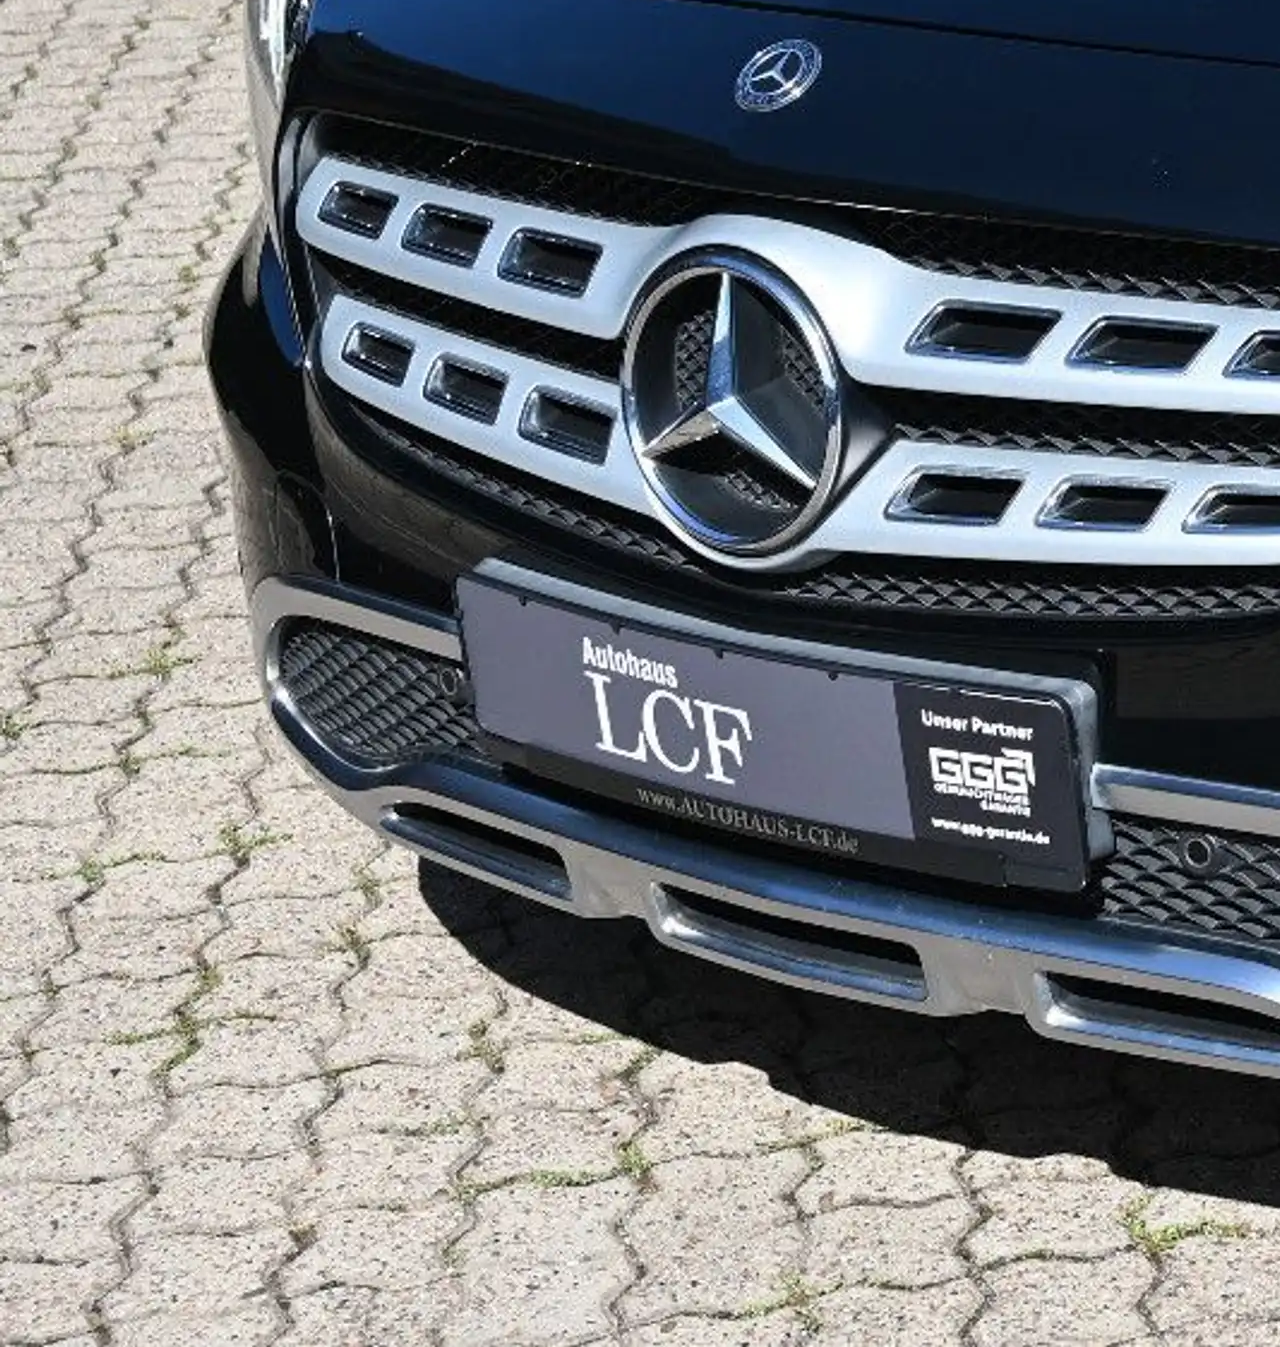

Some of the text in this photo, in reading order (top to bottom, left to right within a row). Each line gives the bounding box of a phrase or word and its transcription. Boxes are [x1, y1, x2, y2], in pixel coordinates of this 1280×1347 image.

[583, 636, 678, 688] Autohaus
[584, 670, 753, 785] LCF
[921, 709, 1034, 741] Unser Partner
[929, 747, 1032, 794] GGG
